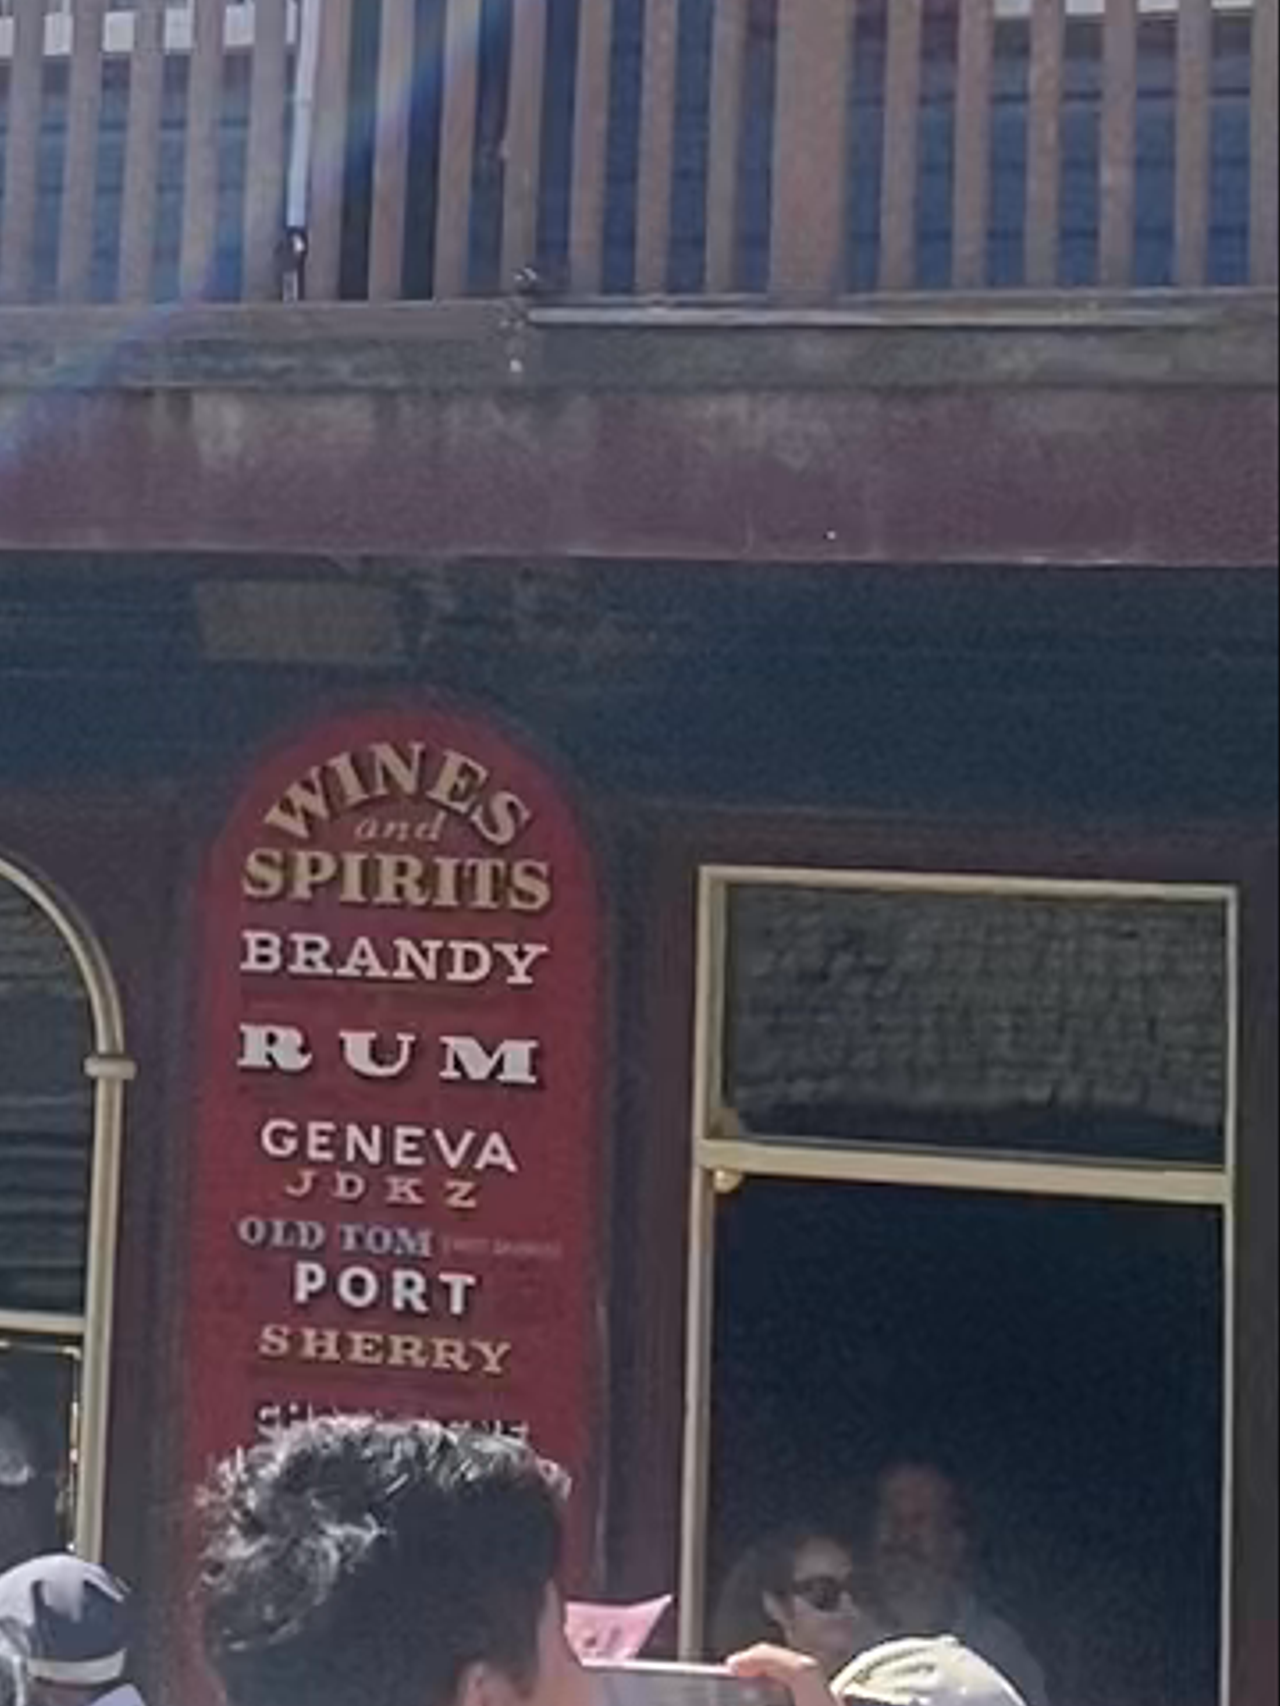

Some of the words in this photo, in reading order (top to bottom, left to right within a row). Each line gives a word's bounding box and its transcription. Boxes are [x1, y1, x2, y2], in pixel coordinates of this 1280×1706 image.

[264, 741, 530, 845] WINES
[353, 810, 446, 843] and
[243, 847, 551, 910] SPIRITS
[241, 930, 548, 985] BRANDY
[237, 1023, 538, 1084] RUM
[261, 1119, 518, 1173] GENEVA
[239, 1217, 325, 1250] OLD
[339, 1224, 432, 1257] TOM
[294, 1262, 476, 1315] PORT
[259, 1325, 511, 1373] SHERRY
